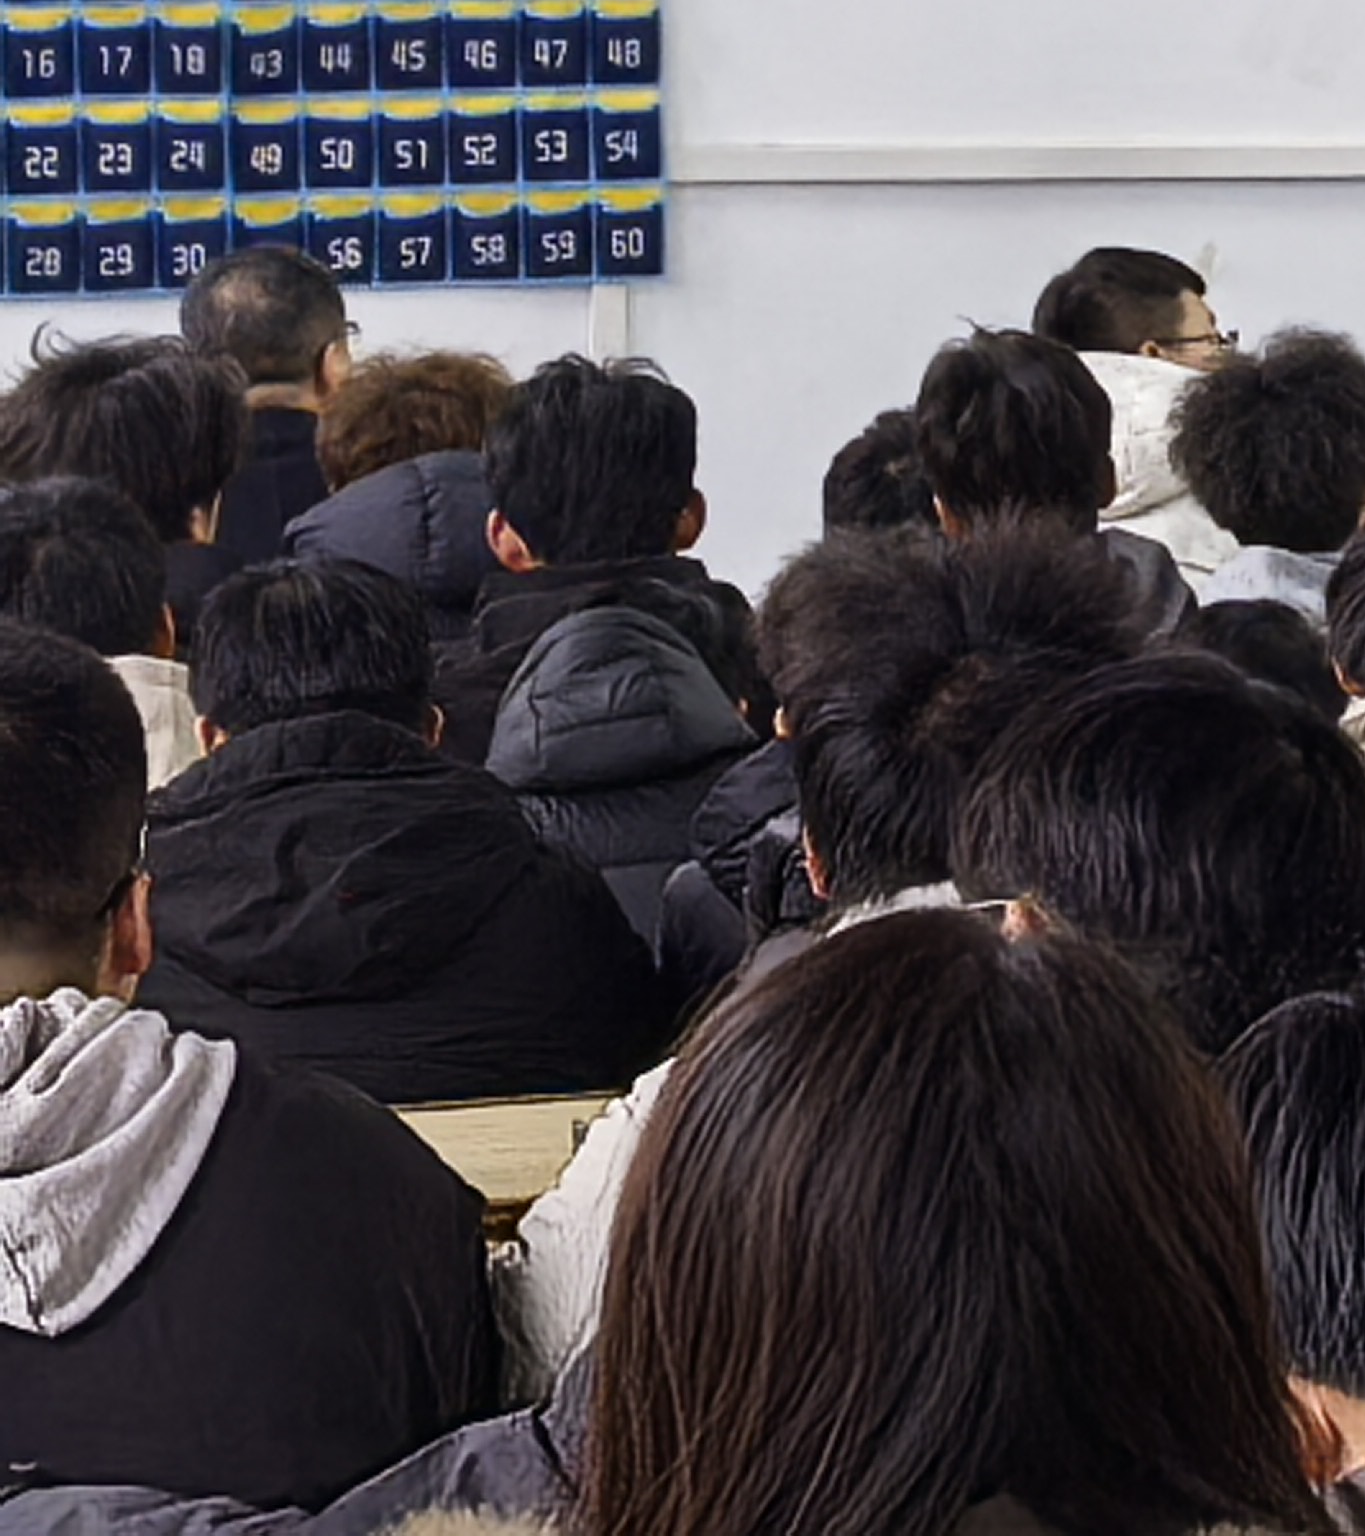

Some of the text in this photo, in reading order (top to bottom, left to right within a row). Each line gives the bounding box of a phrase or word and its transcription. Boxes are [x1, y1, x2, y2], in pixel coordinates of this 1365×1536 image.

[23, 44, 205, 78] 16 17 18
[320, 44, 351, 72] 44
[391, 39, 426, 71] 45
[464, 39, 497, 70] 46
[534, 39, 568, 68] 47
[608, 38, 641, 68] 48
[24, 139, 204, 178] 22 23 24
[250, 129, 638, 175] 49 50 51 52 53 54
[26, 243, 206, 276] 28 29 30
[328, 227, 644, 270] 56 57 58 59 60
